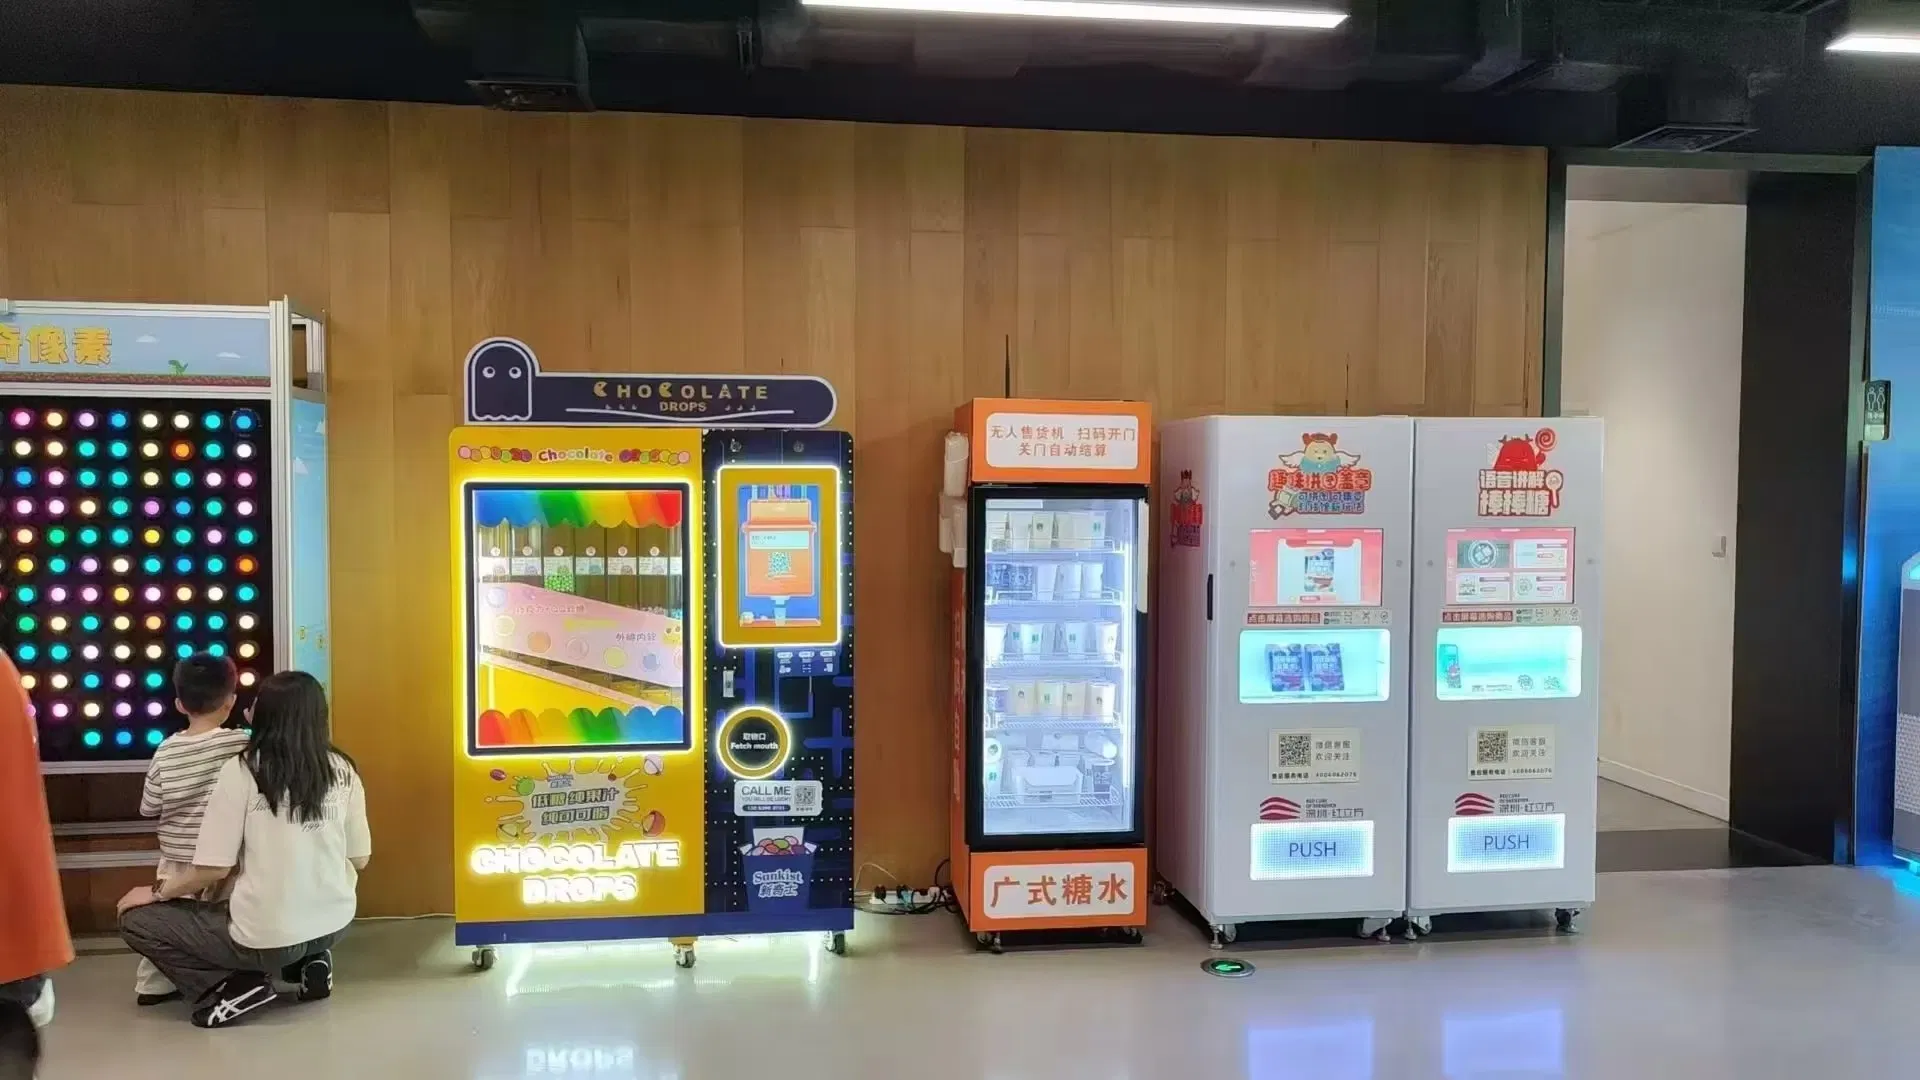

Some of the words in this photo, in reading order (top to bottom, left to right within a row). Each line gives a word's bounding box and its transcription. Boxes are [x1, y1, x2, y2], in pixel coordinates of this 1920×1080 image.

[593, 381, 768, 400] CHOCOLATE
[659, 401, 707, 412] DROPS
[990, 425, 1064, 440] 无人售货机
[1077, 427, 1136, 442] 扫码开门
[538, 446, 613, 463] Chocolate
[1018, 443, 1108, 457] 关门自动结算
[730, 742, 752, 750] Fetch
[753, 741, 779, 750] mouth
[741, 785, 772, 795] CALL
[774, 785, 791, 795] ME
[1289, 841, 1336, 857] PUSH
[1484, 834, 1529, 851] PUSH
[472, 840, 680, 874] CHOCOLATE
[753, 869, 803, 885] Sunkist
[523, 872, 637, 904] DROPS
[758, 884, 799, 897] 新奇士
[990, 873, 1128, 908] 广式糖水
